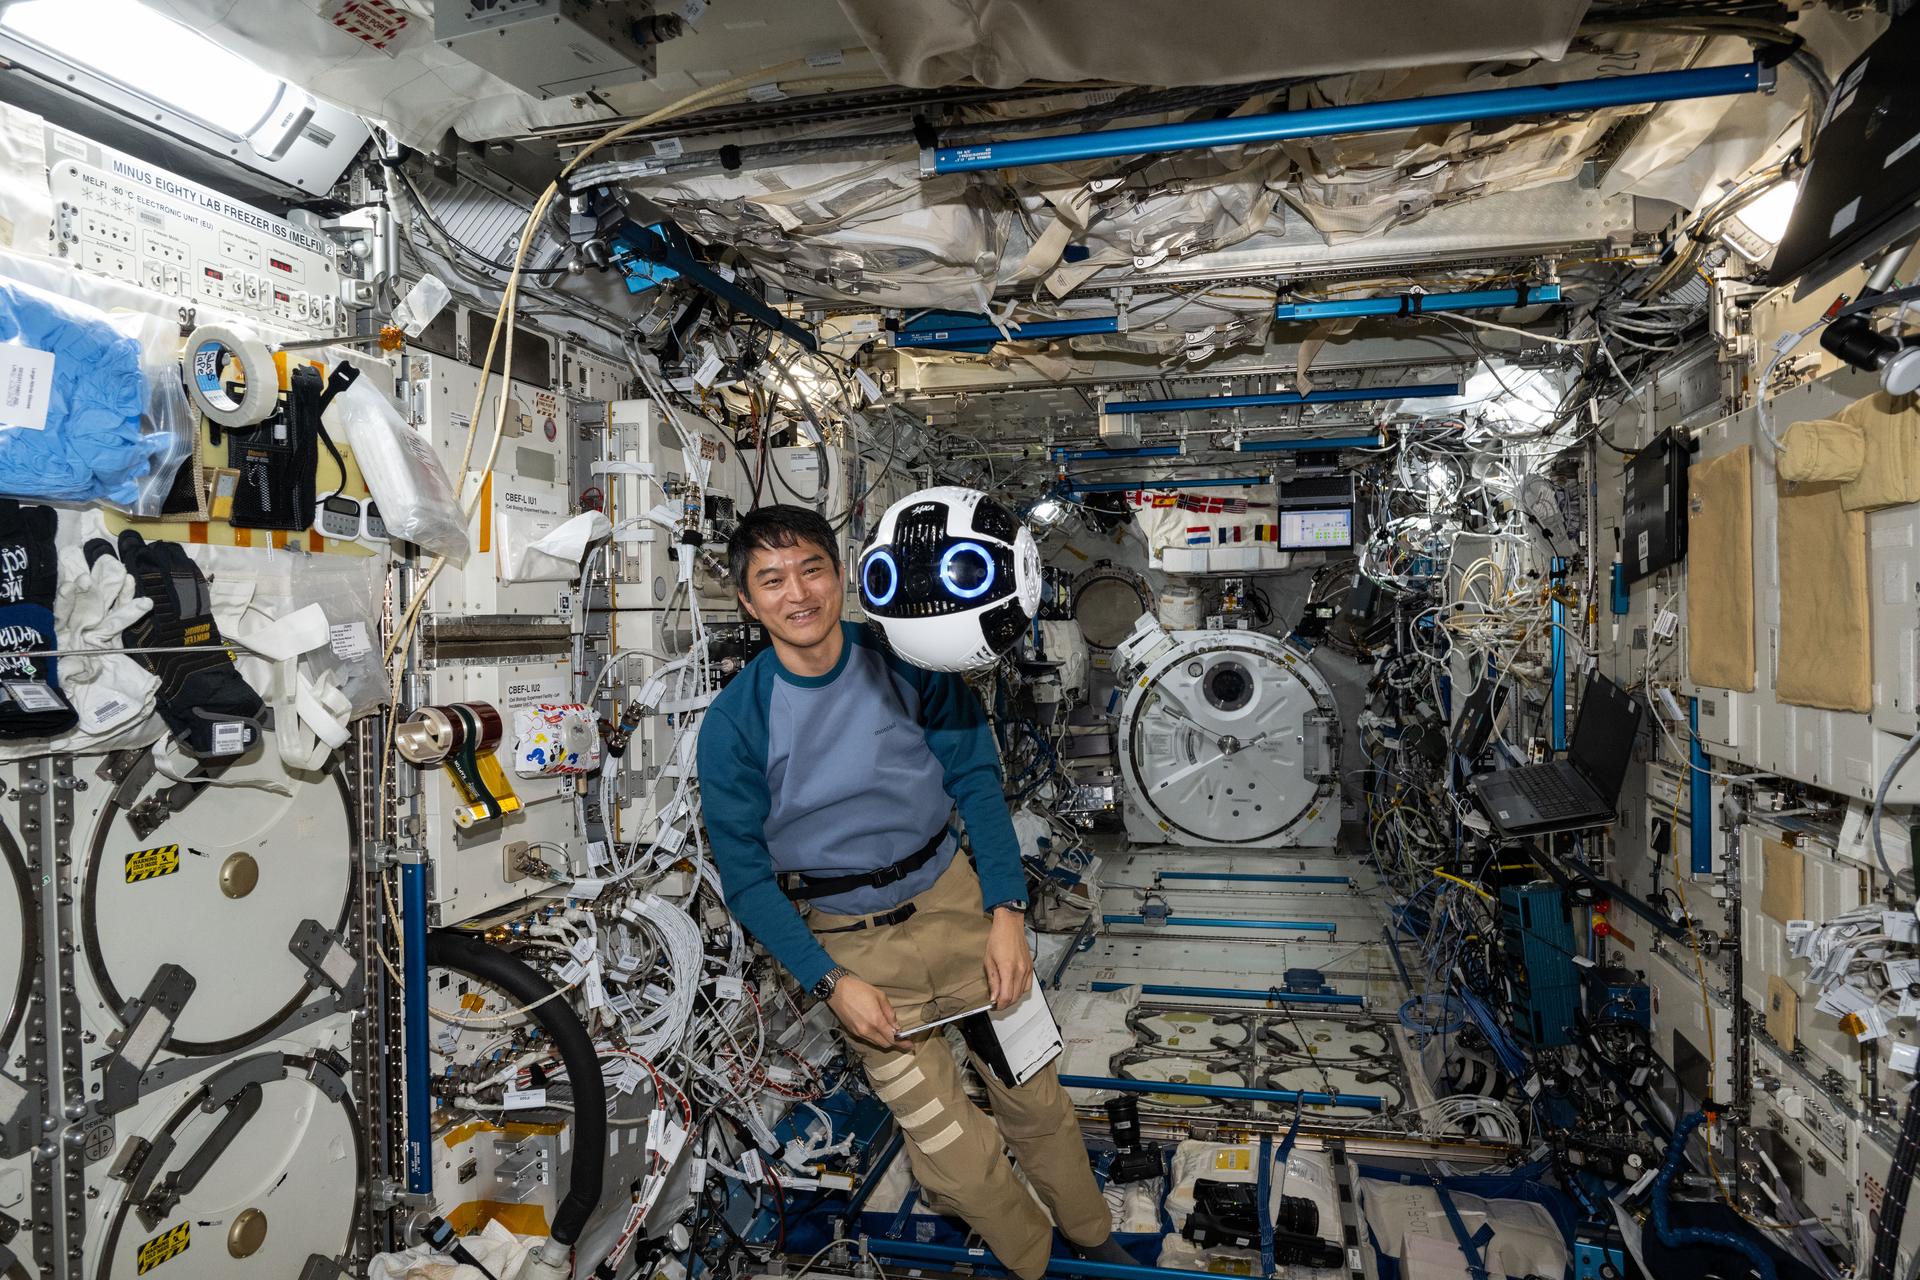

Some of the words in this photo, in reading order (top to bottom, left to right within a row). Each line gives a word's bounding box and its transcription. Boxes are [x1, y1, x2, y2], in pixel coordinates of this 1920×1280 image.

[355, 9, 370, 21] FIRE
[368, 18, 389, 31] PORT
[82, 174, 108, 190] MELFI
[111, 186, 123, 196] -80
[136, 195, 182, 218] ELECTRONIC
[183, 213, 199, 225] UNIT
[200, 220, 214, 232] (EU)
[113, 160, 152, 185] MINUS
[155, 177, 197, 202] EIGHTY
[200, 194, 221, 212] LAB
[224, 204, 270, 231] FREEZER
[272, 223, 287, 238] ISS
[289, 230, 321, 251] (MELFI)
[326, 245, 332, 256] 2
[505, 492, 527, 505] CBEF-L
[911, 504, 936, 517] JAXA
[508, 685, 531, 695] CBEF-L
[132, 855, 158, 866] WARNING
[132, 862, 145, 871] COLD
[145, 1239, 170, 1255] WARNING
